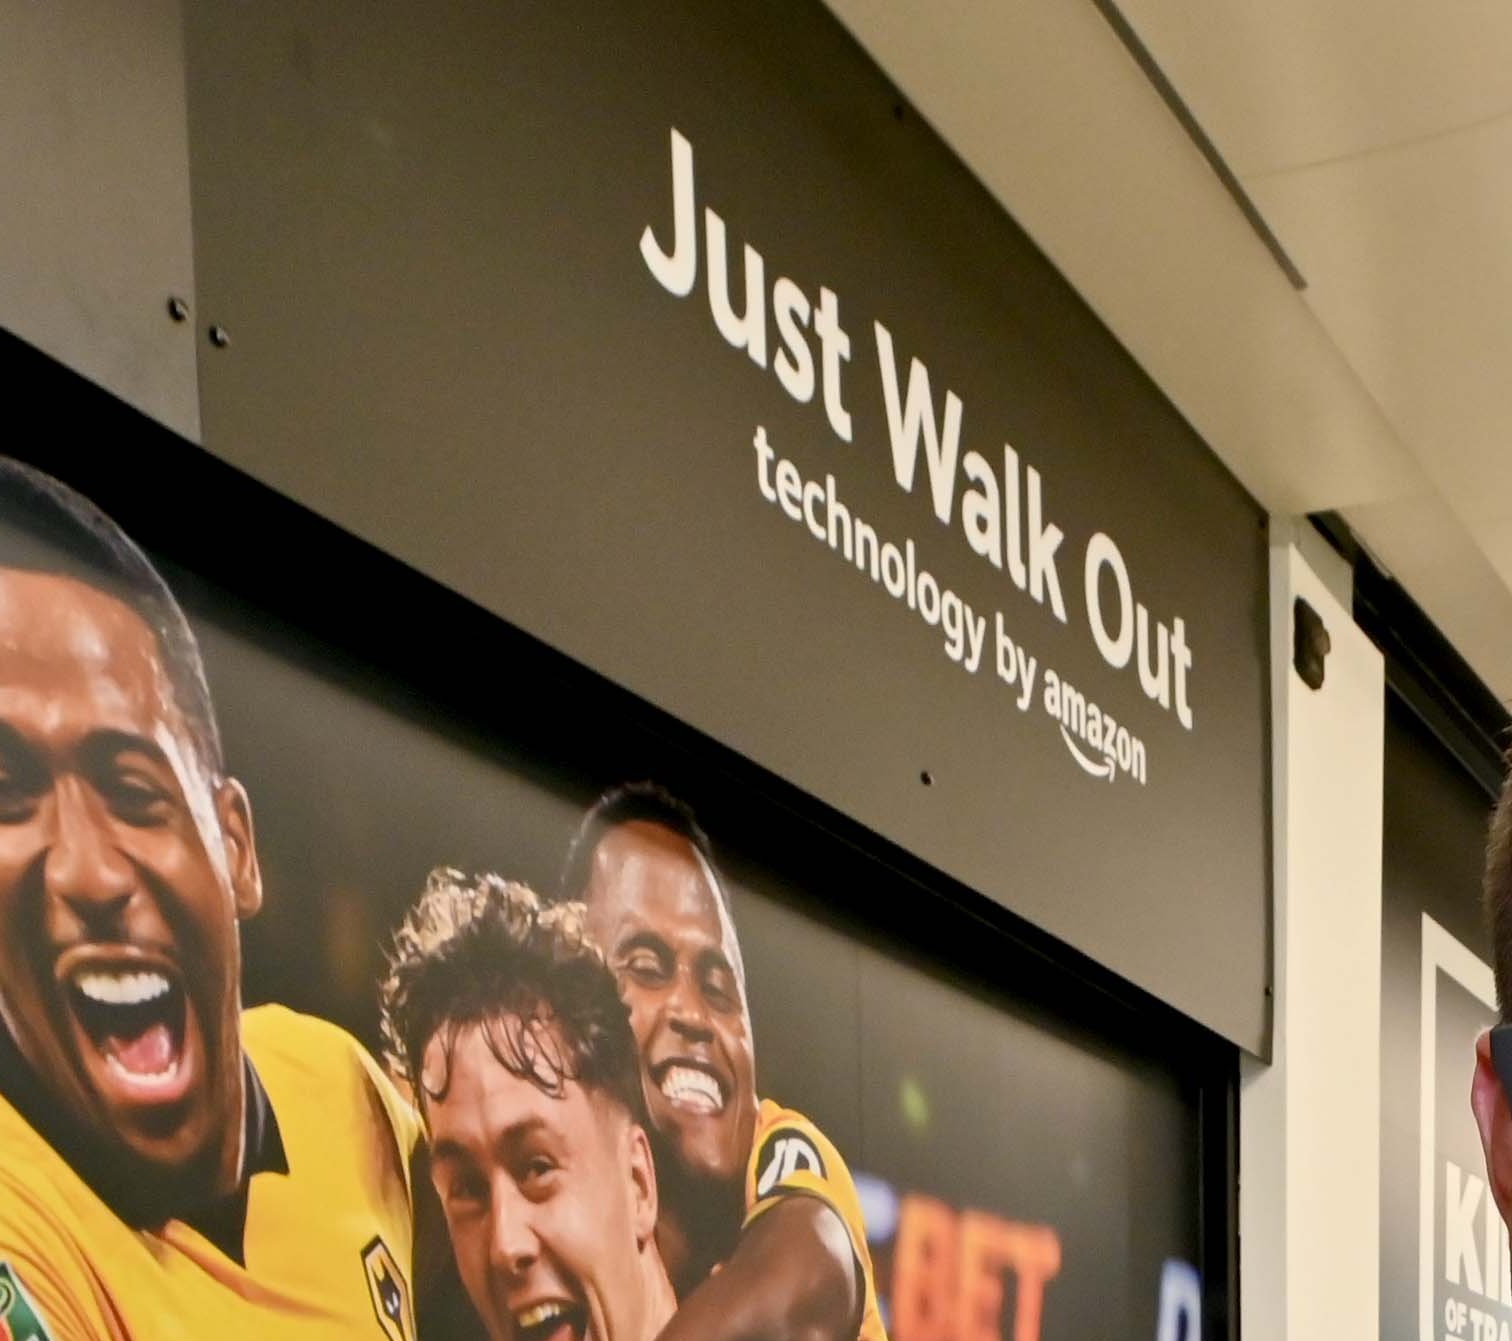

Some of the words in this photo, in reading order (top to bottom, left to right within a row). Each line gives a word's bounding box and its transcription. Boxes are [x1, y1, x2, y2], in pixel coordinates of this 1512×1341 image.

[639, 126, 852, 442] Just
[874, 319, 1067, 622] Walk
[1085, 531, 1193, 729] Out
[753, 425, 986, 672] technology
[995, 612, 1038, 710] by
[1044, 666, 1146, 784] amazon
[1444, 1297, 1468, 1334] OF
